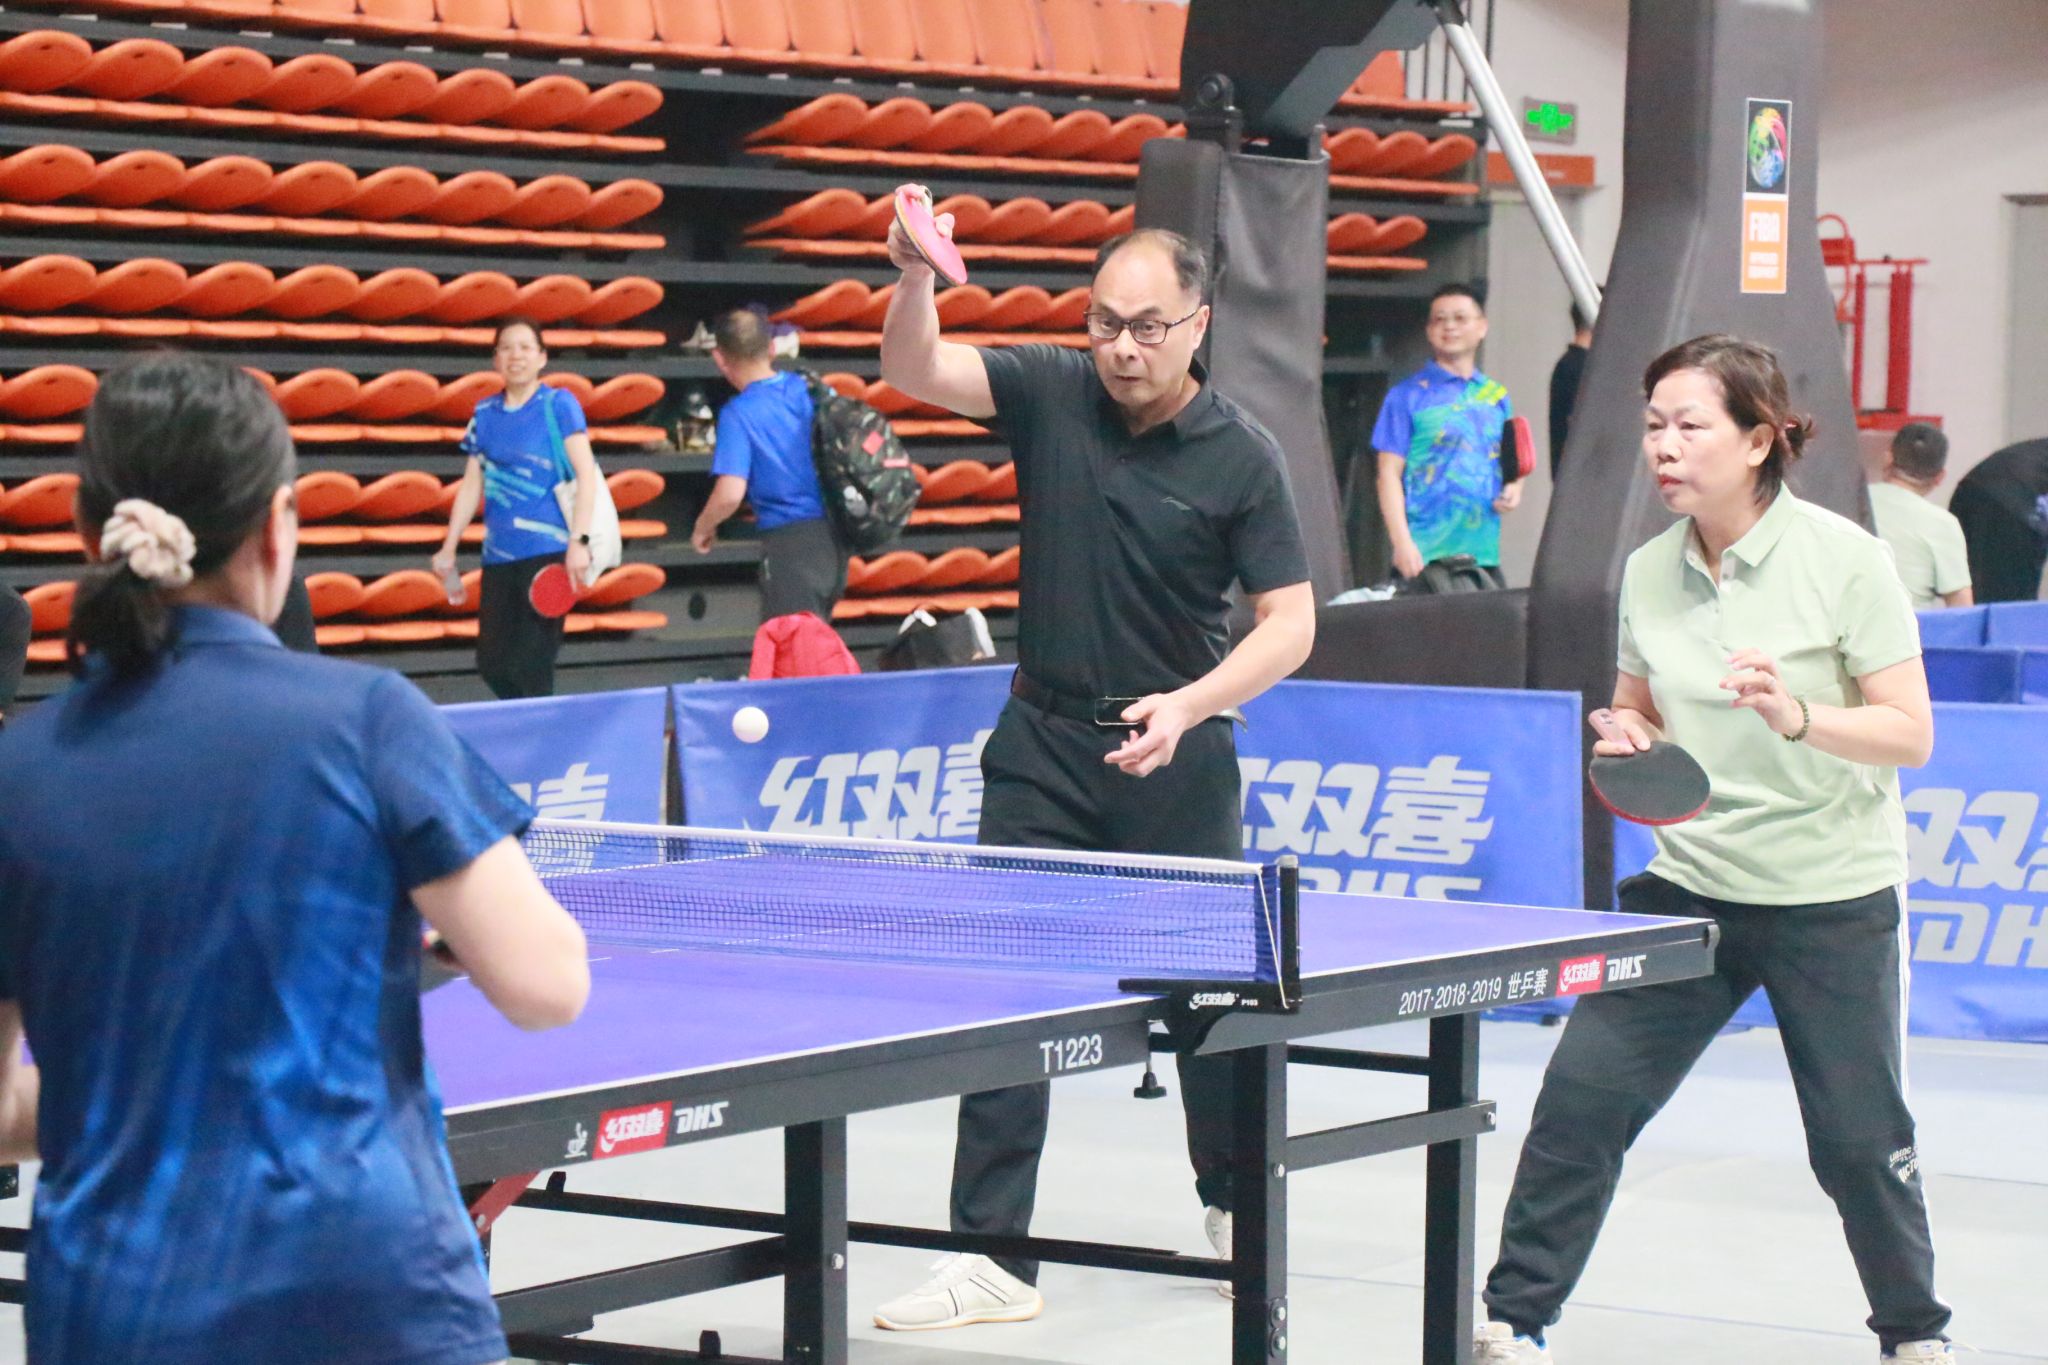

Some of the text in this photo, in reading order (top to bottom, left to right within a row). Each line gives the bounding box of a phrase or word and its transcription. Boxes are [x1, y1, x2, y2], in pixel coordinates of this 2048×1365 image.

[1237, 755, 1494, 865] 双喜
[1902, 787, 2048, 892] 双
[1507, 967, 1549, 1000] 世乒赛
[1606, 955, 1647, 982] DHS
[1039, 1033, 1103, 1074] T1223
[674, 1101, 729, 1134] DHS
